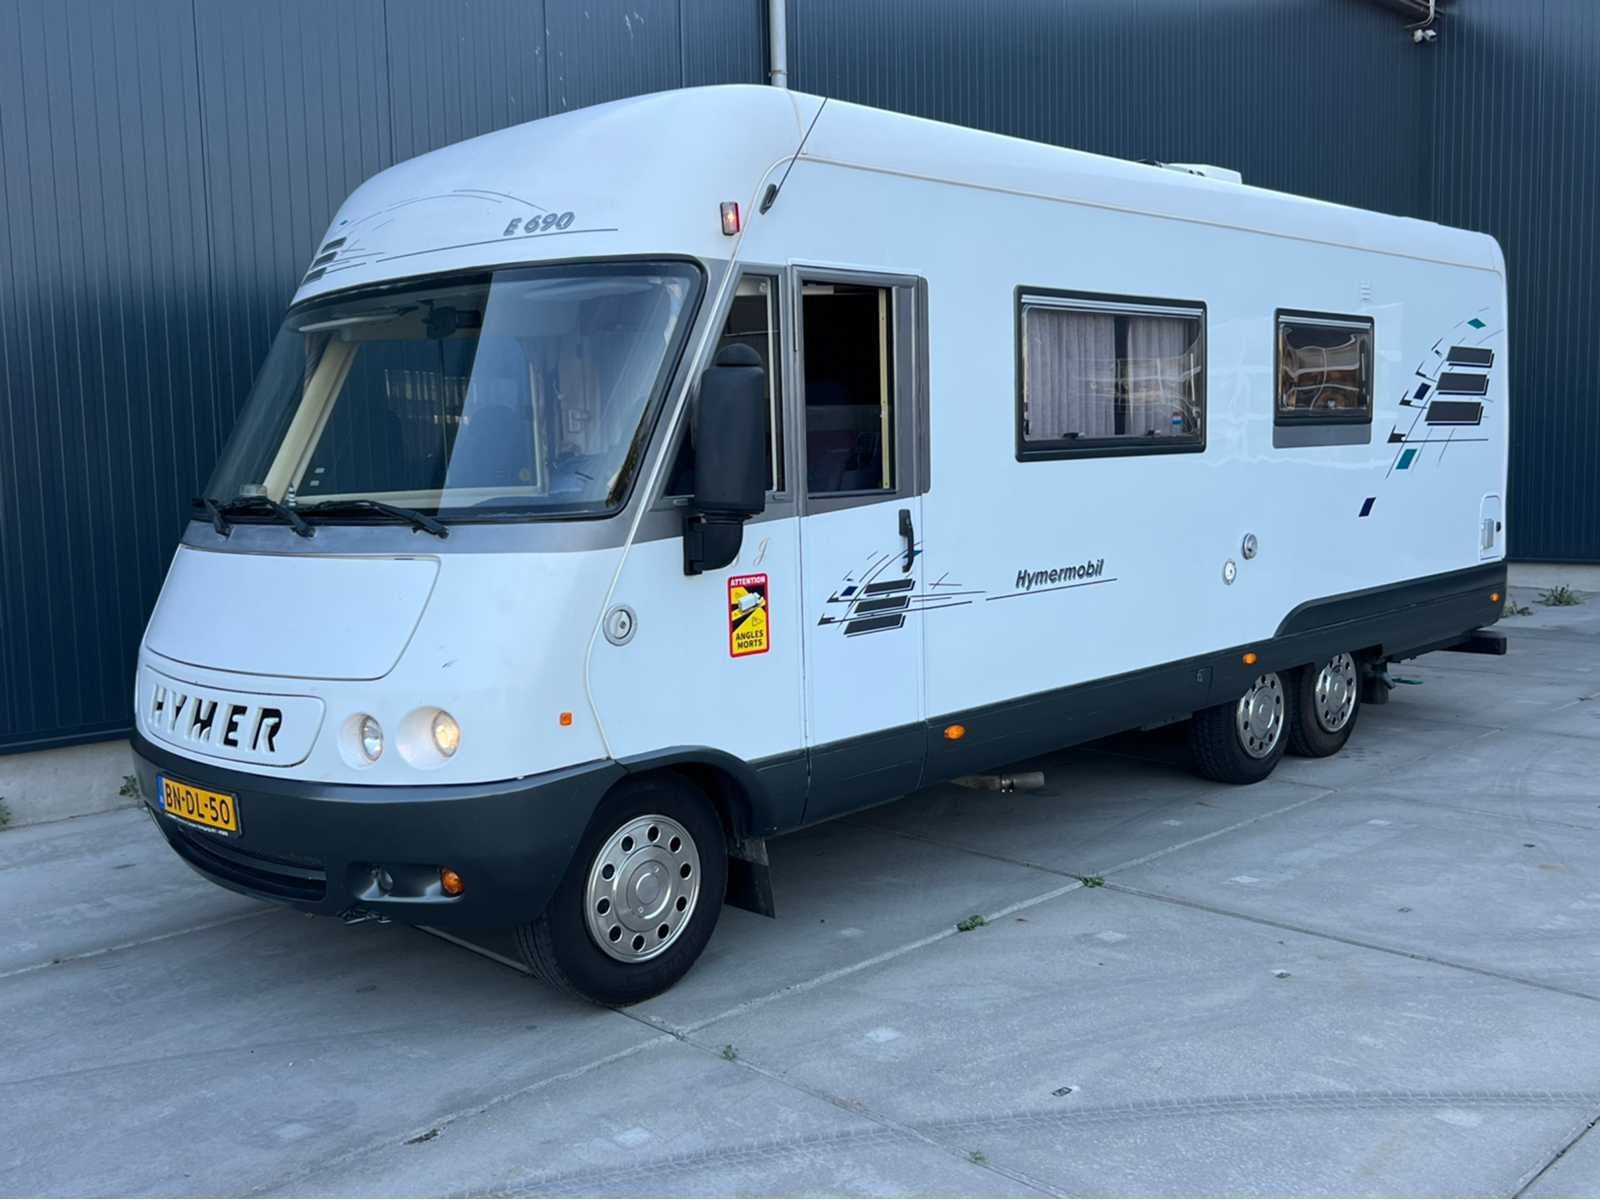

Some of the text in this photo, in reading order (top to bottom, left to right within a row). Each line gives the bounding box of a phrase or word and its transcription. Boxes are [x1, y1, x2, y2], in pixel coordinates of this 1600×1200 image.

[503, 211, 575, 236] E 690
[730, 576, 766, 587] ATTENTION
[1015, 558, 1104, 591] Hymermobil
[736, 630, 764, 642] ANGLES
[737, 639, 763, 650] MORTS
[151, 683, 283, 752] HYMER
[165, 783, 230, 825] BN-DL-50
